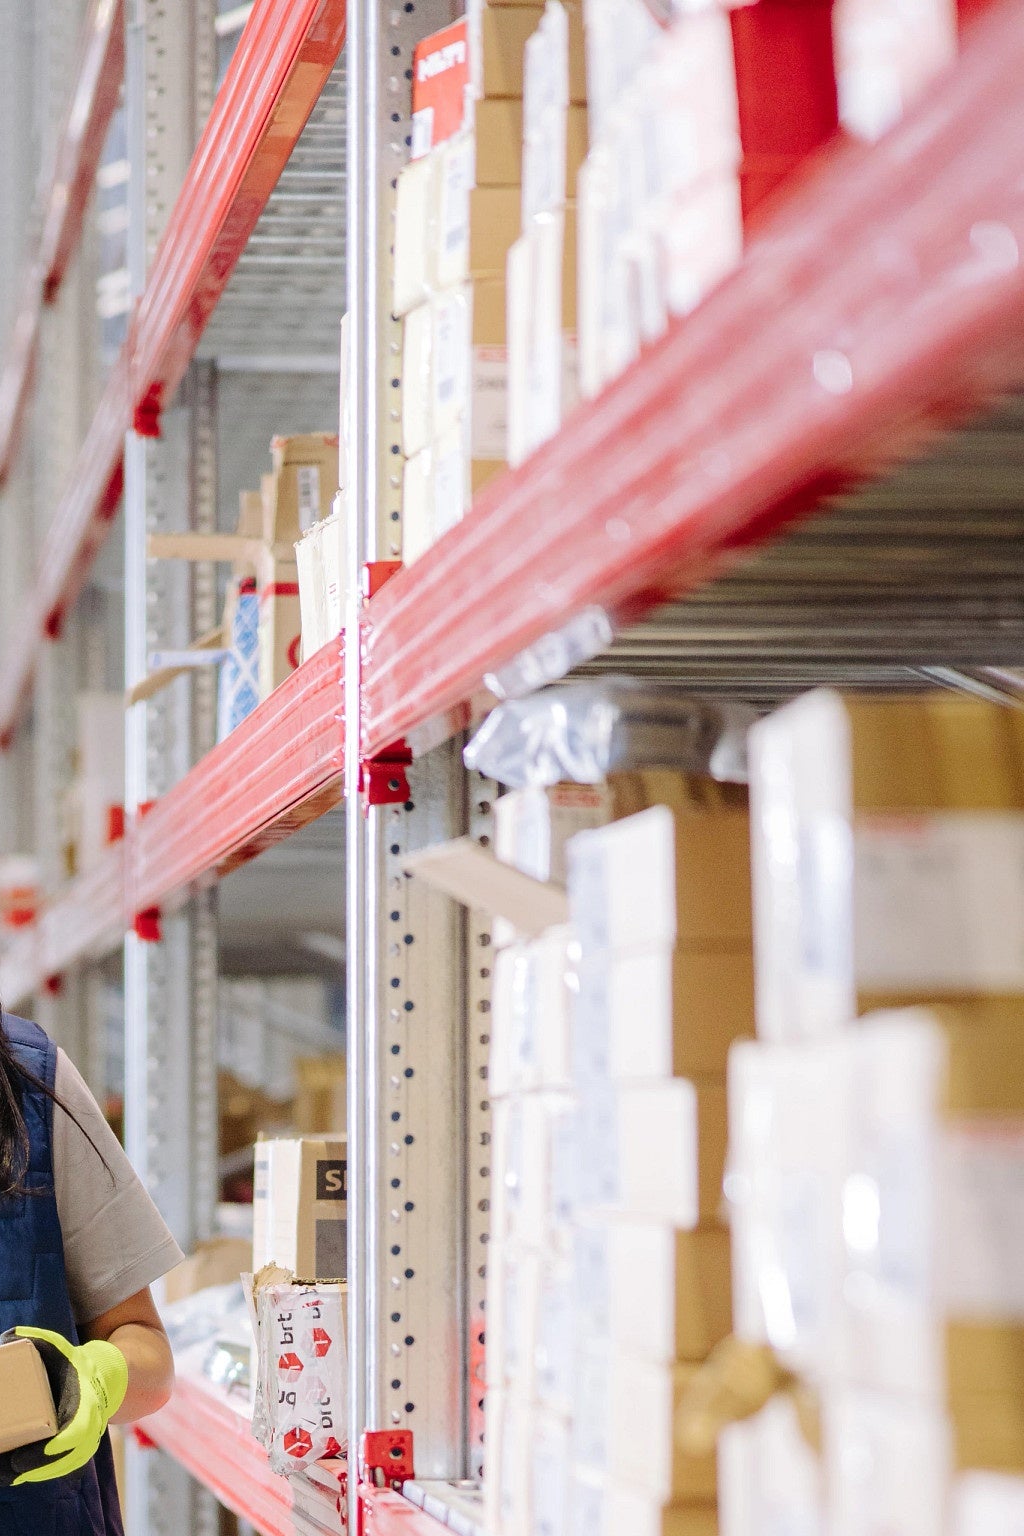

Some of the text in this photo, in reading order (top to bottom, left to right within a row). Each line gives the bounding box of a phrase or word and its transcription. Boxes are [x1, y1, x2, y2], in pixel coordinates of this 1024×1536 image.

[326, 1169, 347, 1191] S
[278, 1312, 294, 1345] brt
[278, 1390, 296, 1408] br
